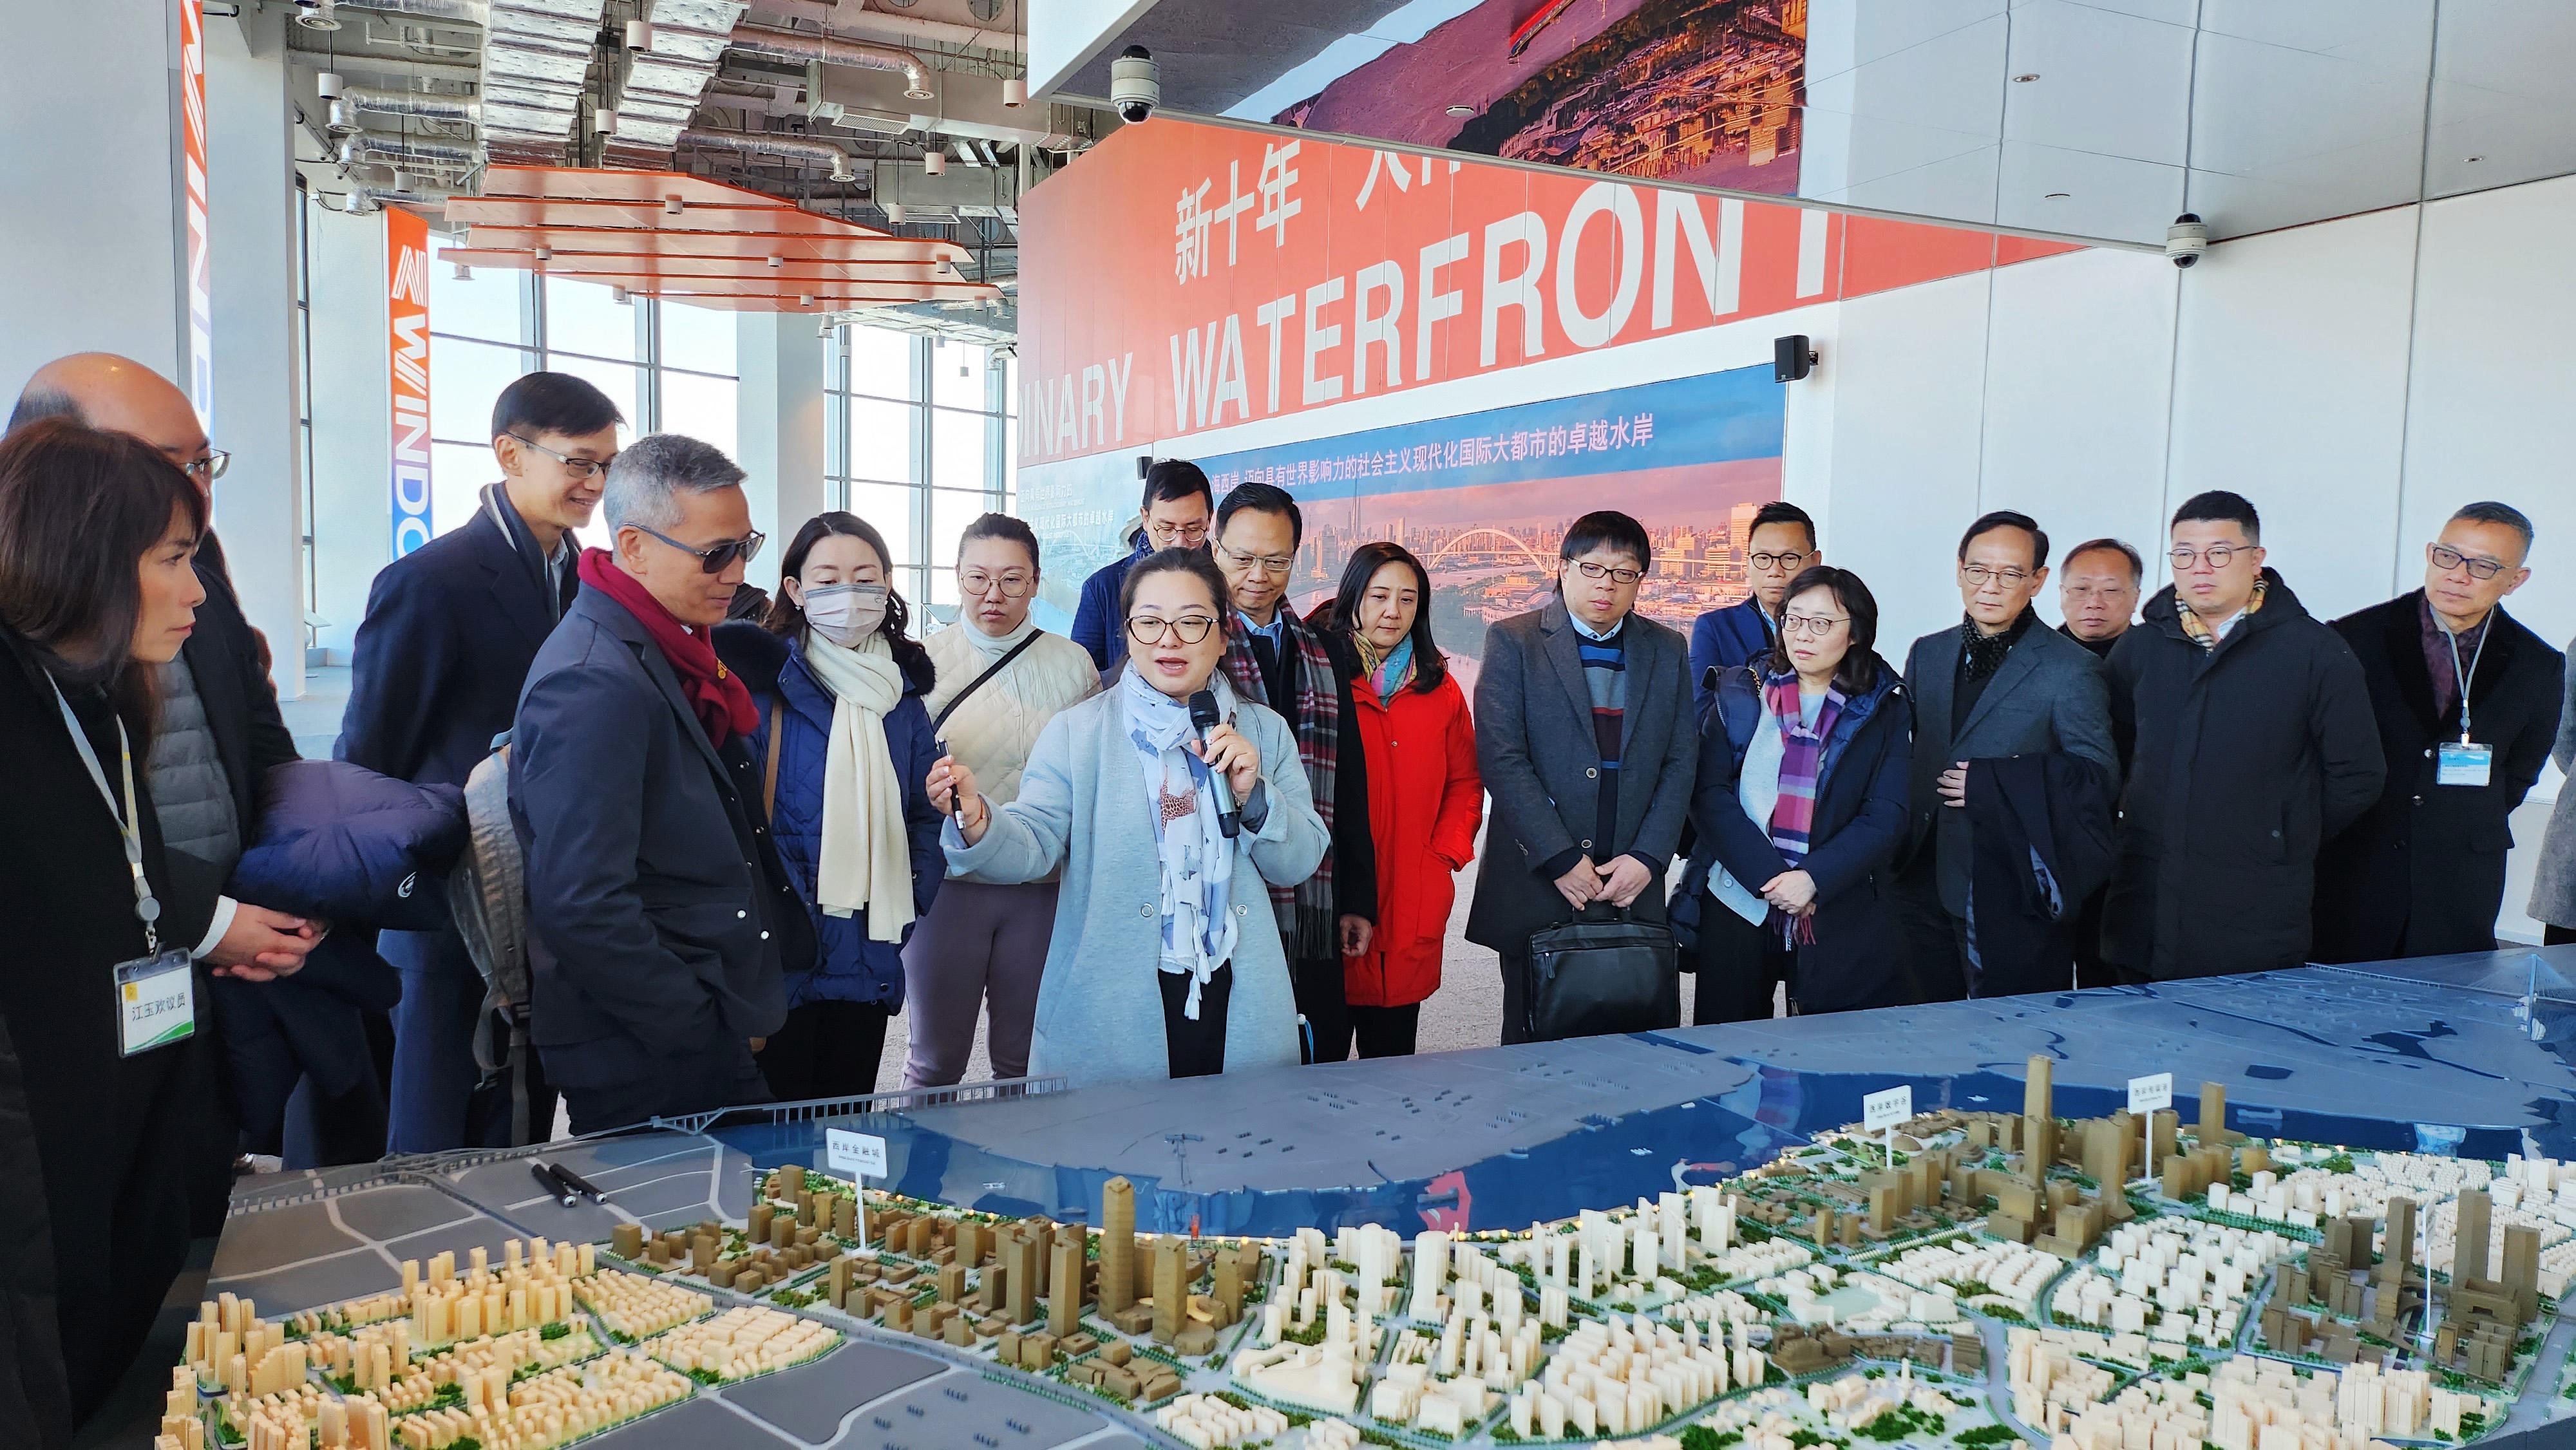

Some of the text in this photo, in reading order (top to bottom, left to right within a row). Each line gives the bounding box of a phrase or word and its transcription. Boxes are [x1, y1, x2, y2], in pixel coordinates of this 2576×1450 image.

[1175, 139, 1301, 285] 新十年
[831, 1140, 880, 1158] 西岸金融城
